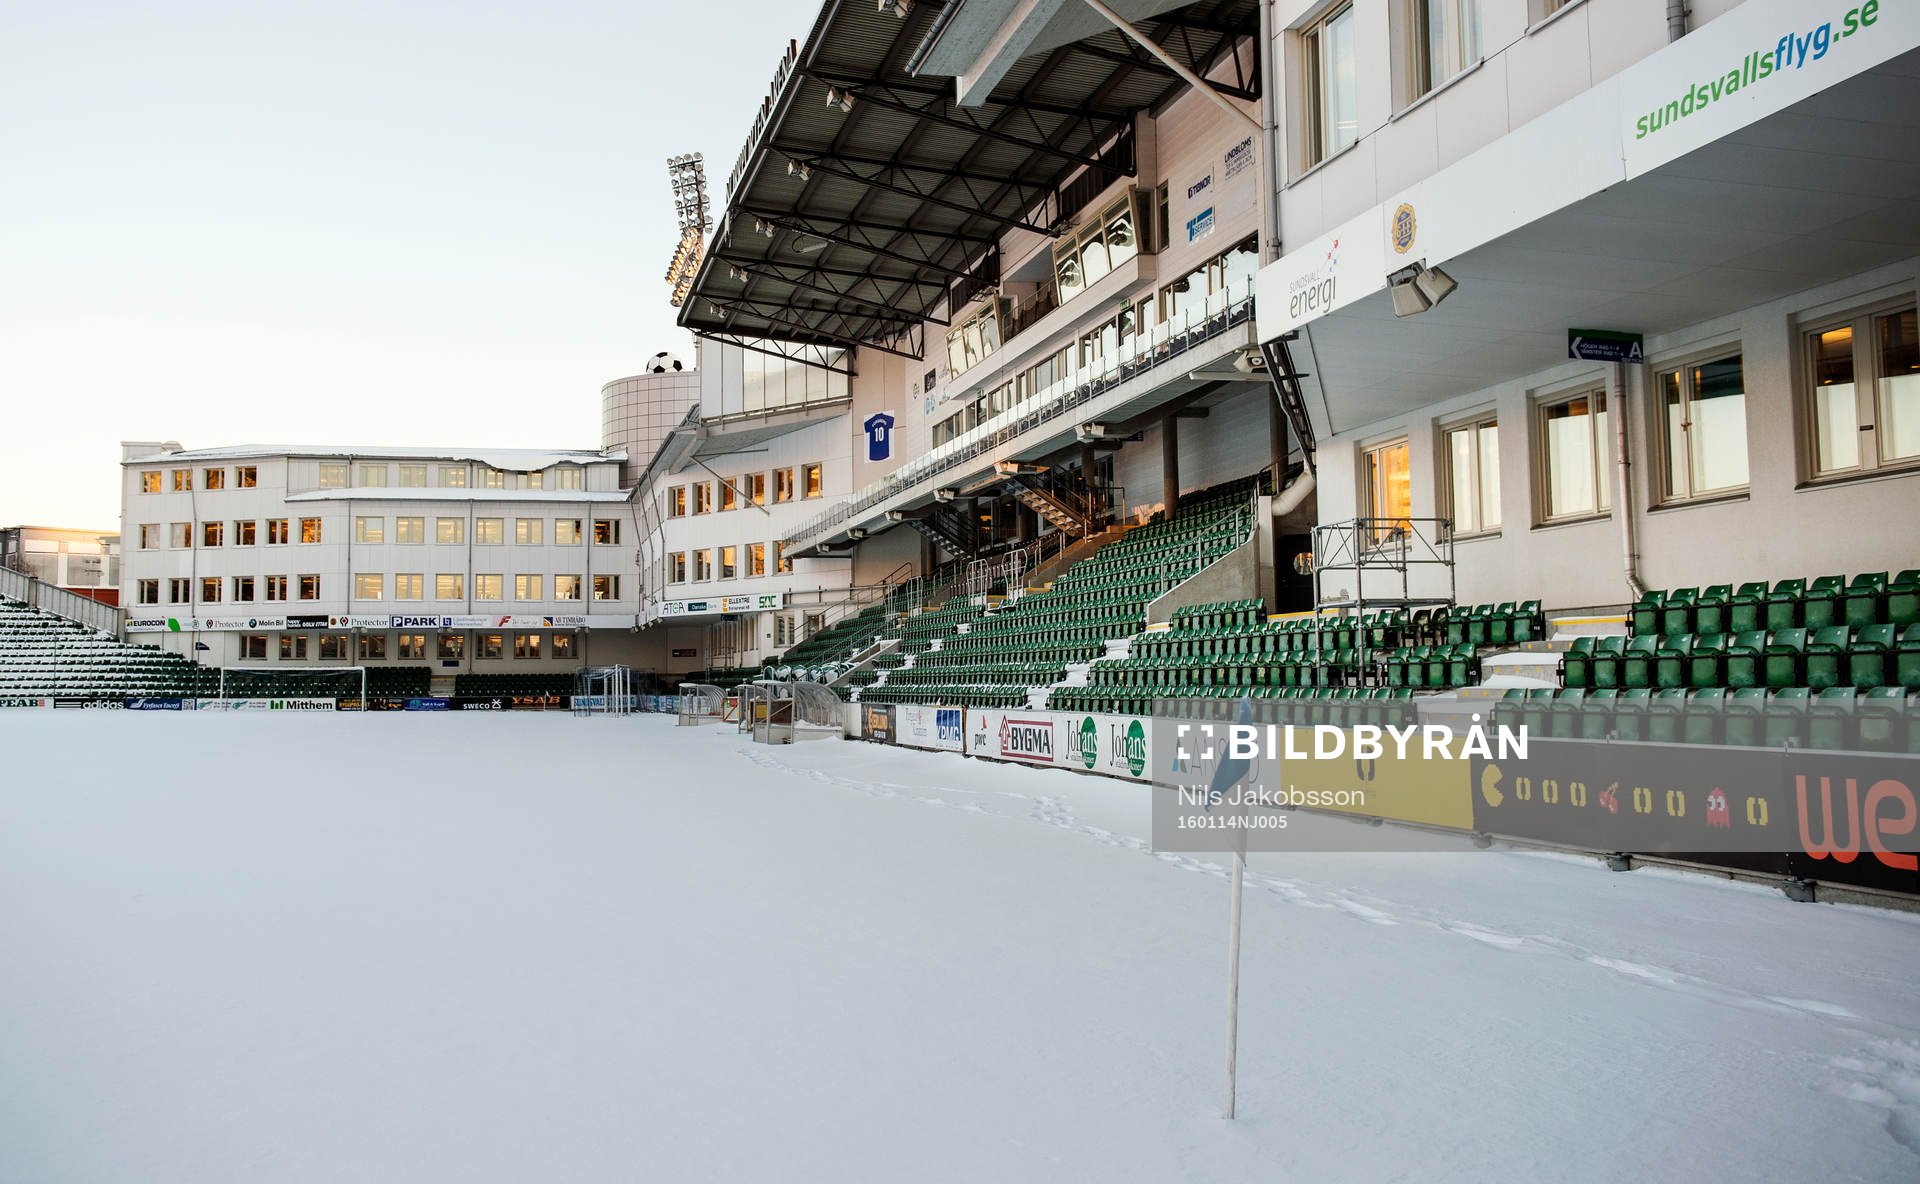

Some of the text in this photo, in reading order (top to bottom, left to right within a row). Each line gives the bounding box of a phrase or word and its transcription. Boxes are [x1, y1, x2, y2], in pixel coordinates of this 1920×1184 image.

[1636, 0, 1880, 140] sundsvallsflyg.se
[1290, 276, 1336, 319] energi
[1629, 341, 1642, 358] A
[874, 426, 885, 442] 10
[663, 602, 685, 614] ATEA
[215, 619, 244, 628] Protector
[351, 618, 388, 626] Protector
[404, 617, 437, 626] PARK
[83, 700, 124, 709] adidas
[286, 700, 333, 710] Mitthem
[512, 696, 561, 704] YSAB
[974, 733, 987, 750] pwc
[1011, 727, 1050, 754] BYGMA
[1065, 720, 1098, 760] Johans
[1110, 723, 1146, 767] Johans
